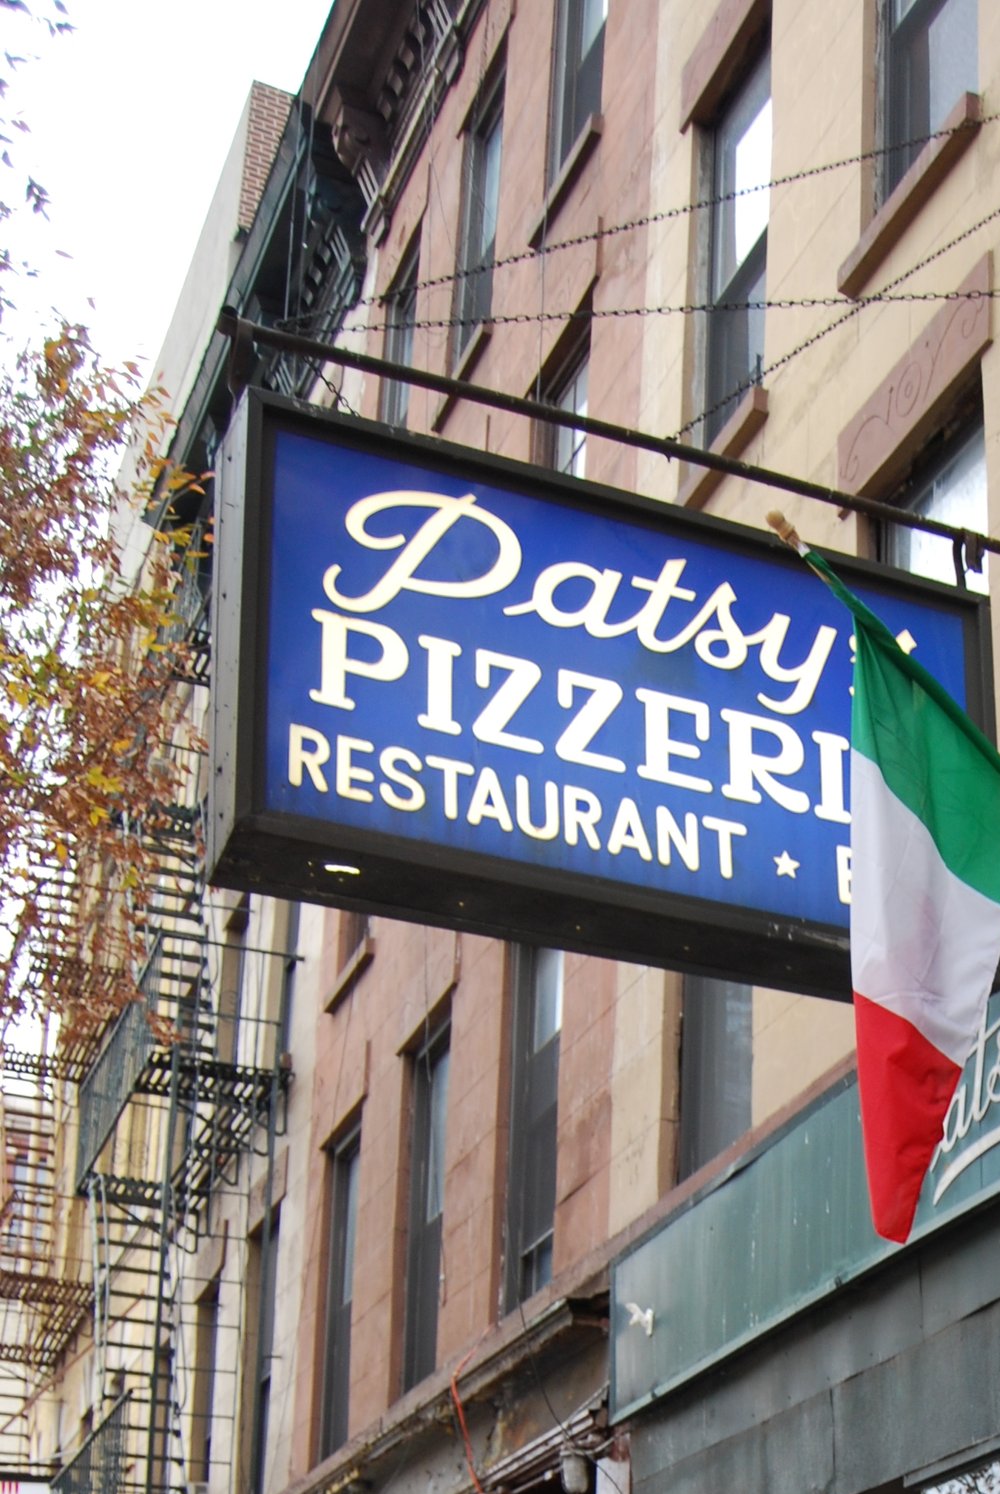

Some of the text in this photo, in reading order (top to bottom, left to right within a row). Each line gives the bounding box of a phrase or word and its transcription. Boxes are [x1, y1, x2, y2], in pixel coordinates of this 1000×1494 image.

[322, 489, 917, 714] Patsy
[287, 723, 748, 879] RESTAURANT
[308, 608, 852, 824] PIZZERI
